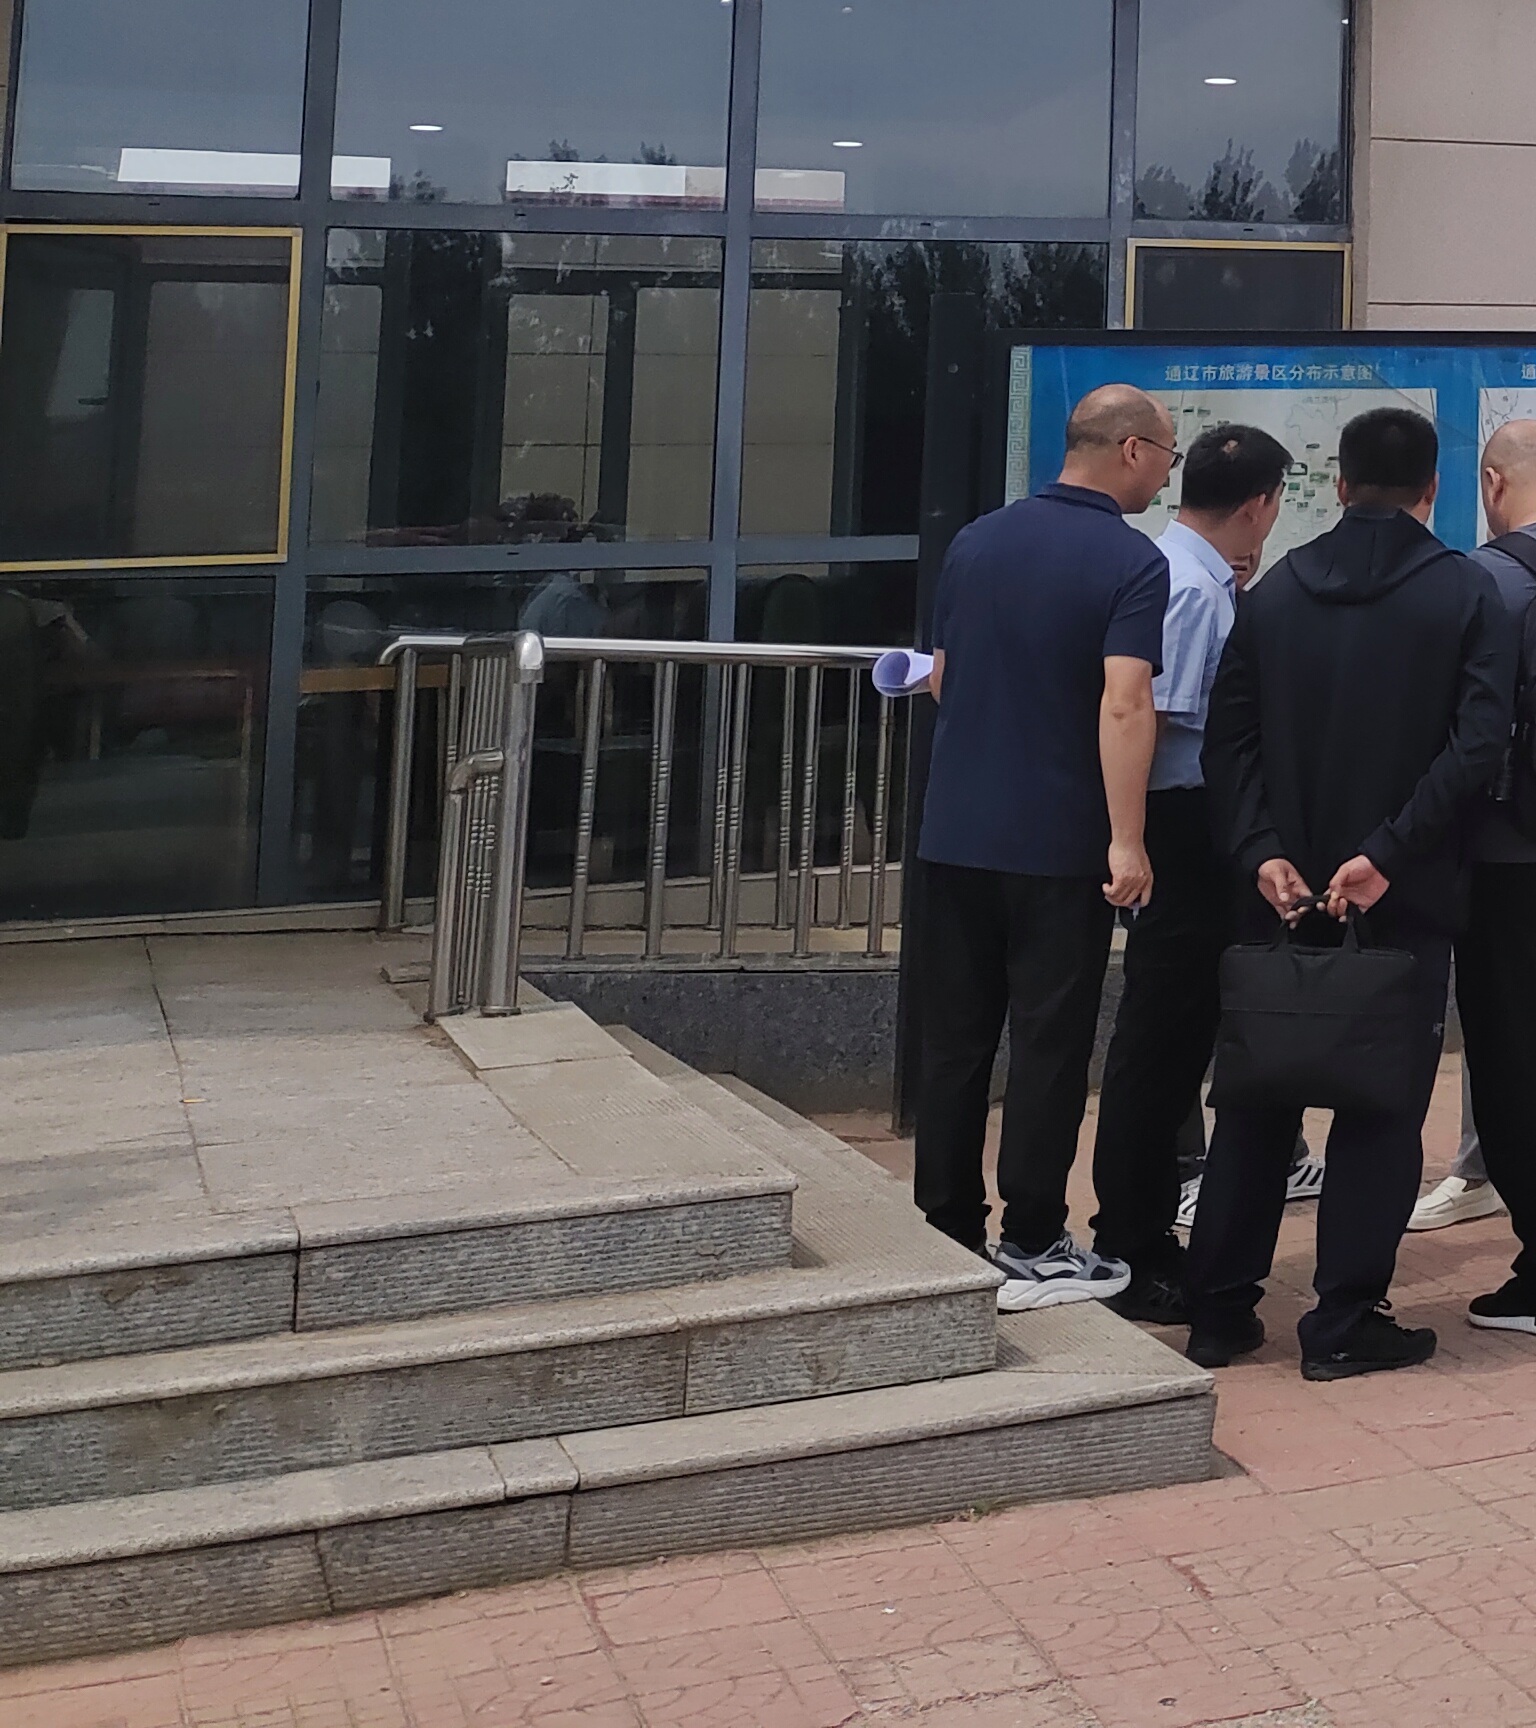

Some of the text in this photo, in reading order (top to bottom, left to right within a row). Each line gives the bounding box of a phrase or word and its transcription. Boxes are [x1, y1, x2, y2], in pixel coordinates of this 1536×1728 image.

[1164, 363, 1373, 382] 通辽市旅游景区分布示意图
